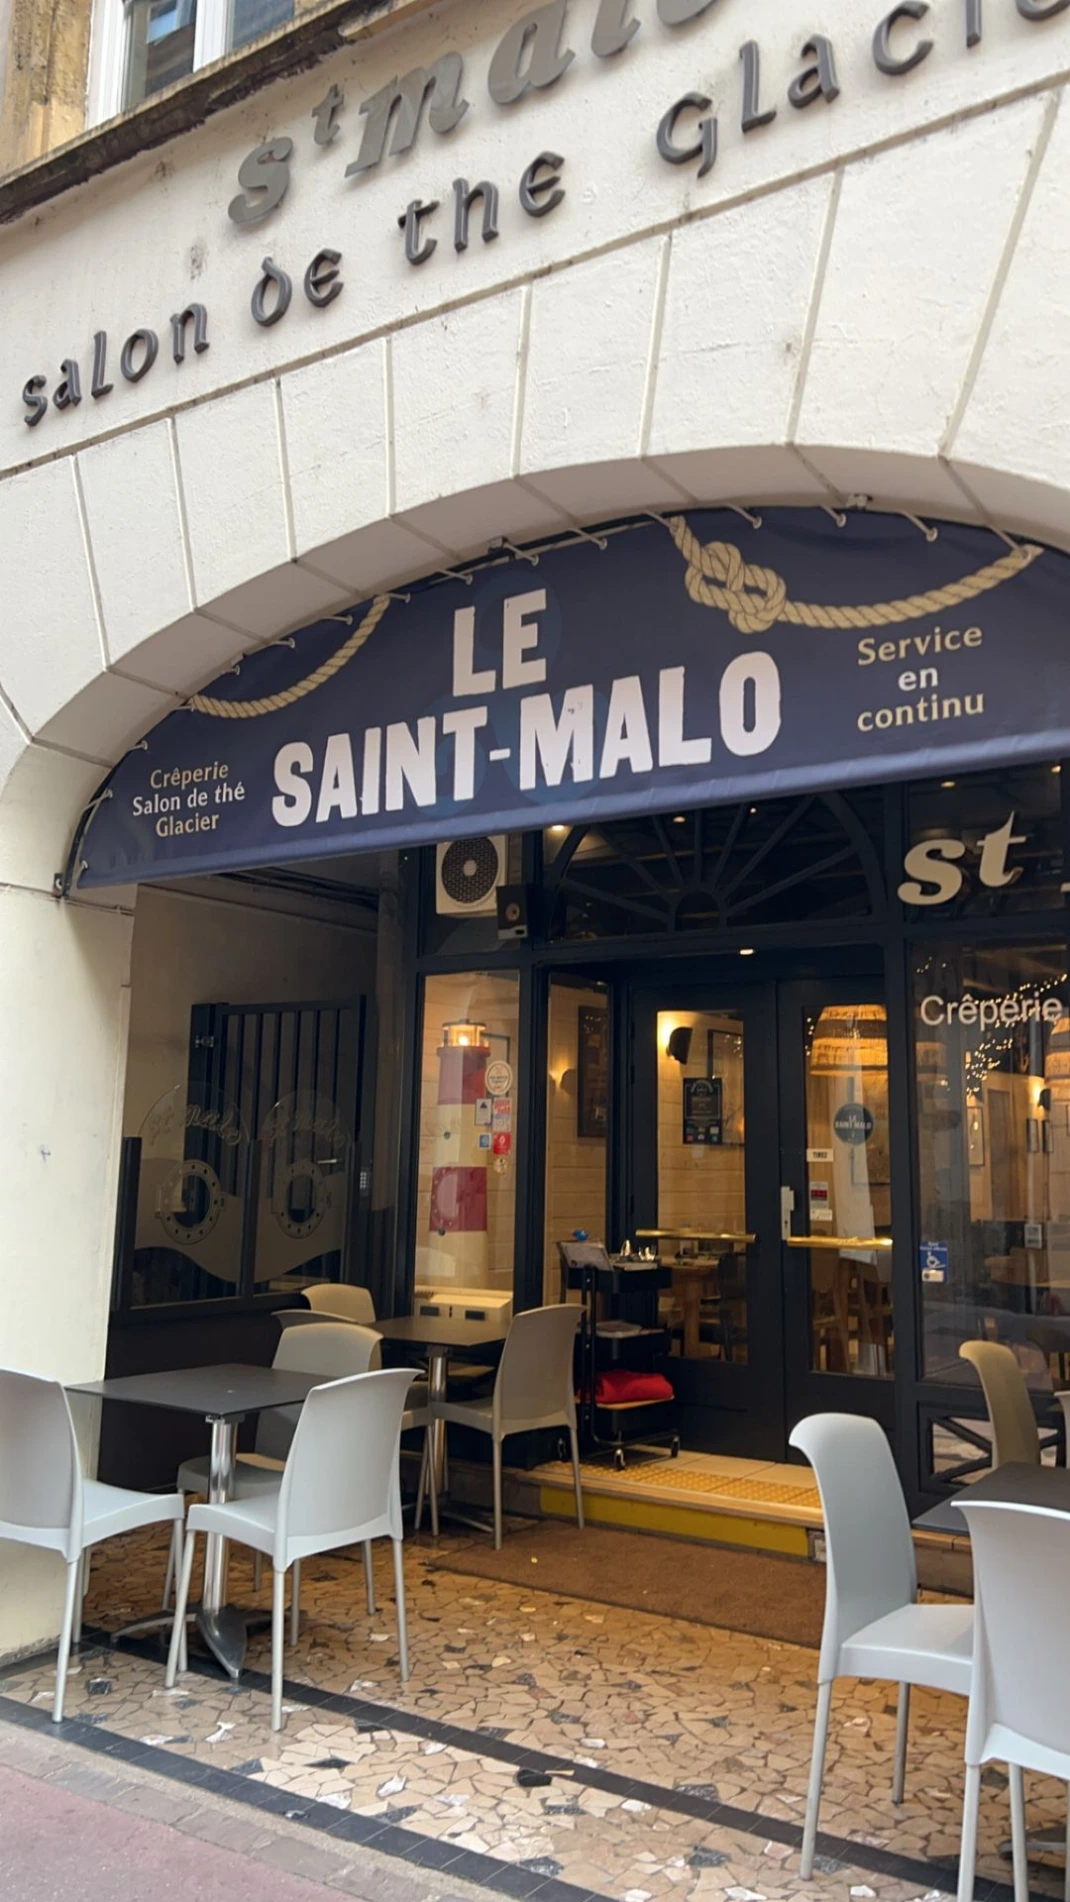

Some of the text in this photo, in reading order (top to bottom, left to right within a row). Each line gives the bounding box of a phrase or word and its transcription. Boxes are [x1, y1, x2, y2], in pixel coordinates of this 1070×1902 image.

[22, 303, 209, 427] salon
[251, 249, 344, 327] de
[656, 0, 1070, 178] Glaci
[452, 588, 547, 697] LE
[857, 626, 983, 665] Service
[898, 667, 938, 691] en
[857, 692, 984, 732] continu
[271, 650, 782, 828] SAINT-MALO
[150, 761, 229, 790] Crêperie
[132, 781, 245, 816] Salon de thé
[155, 812, 219, 837] Glacier
[920, 993, 1063, 1031] Crêperie
